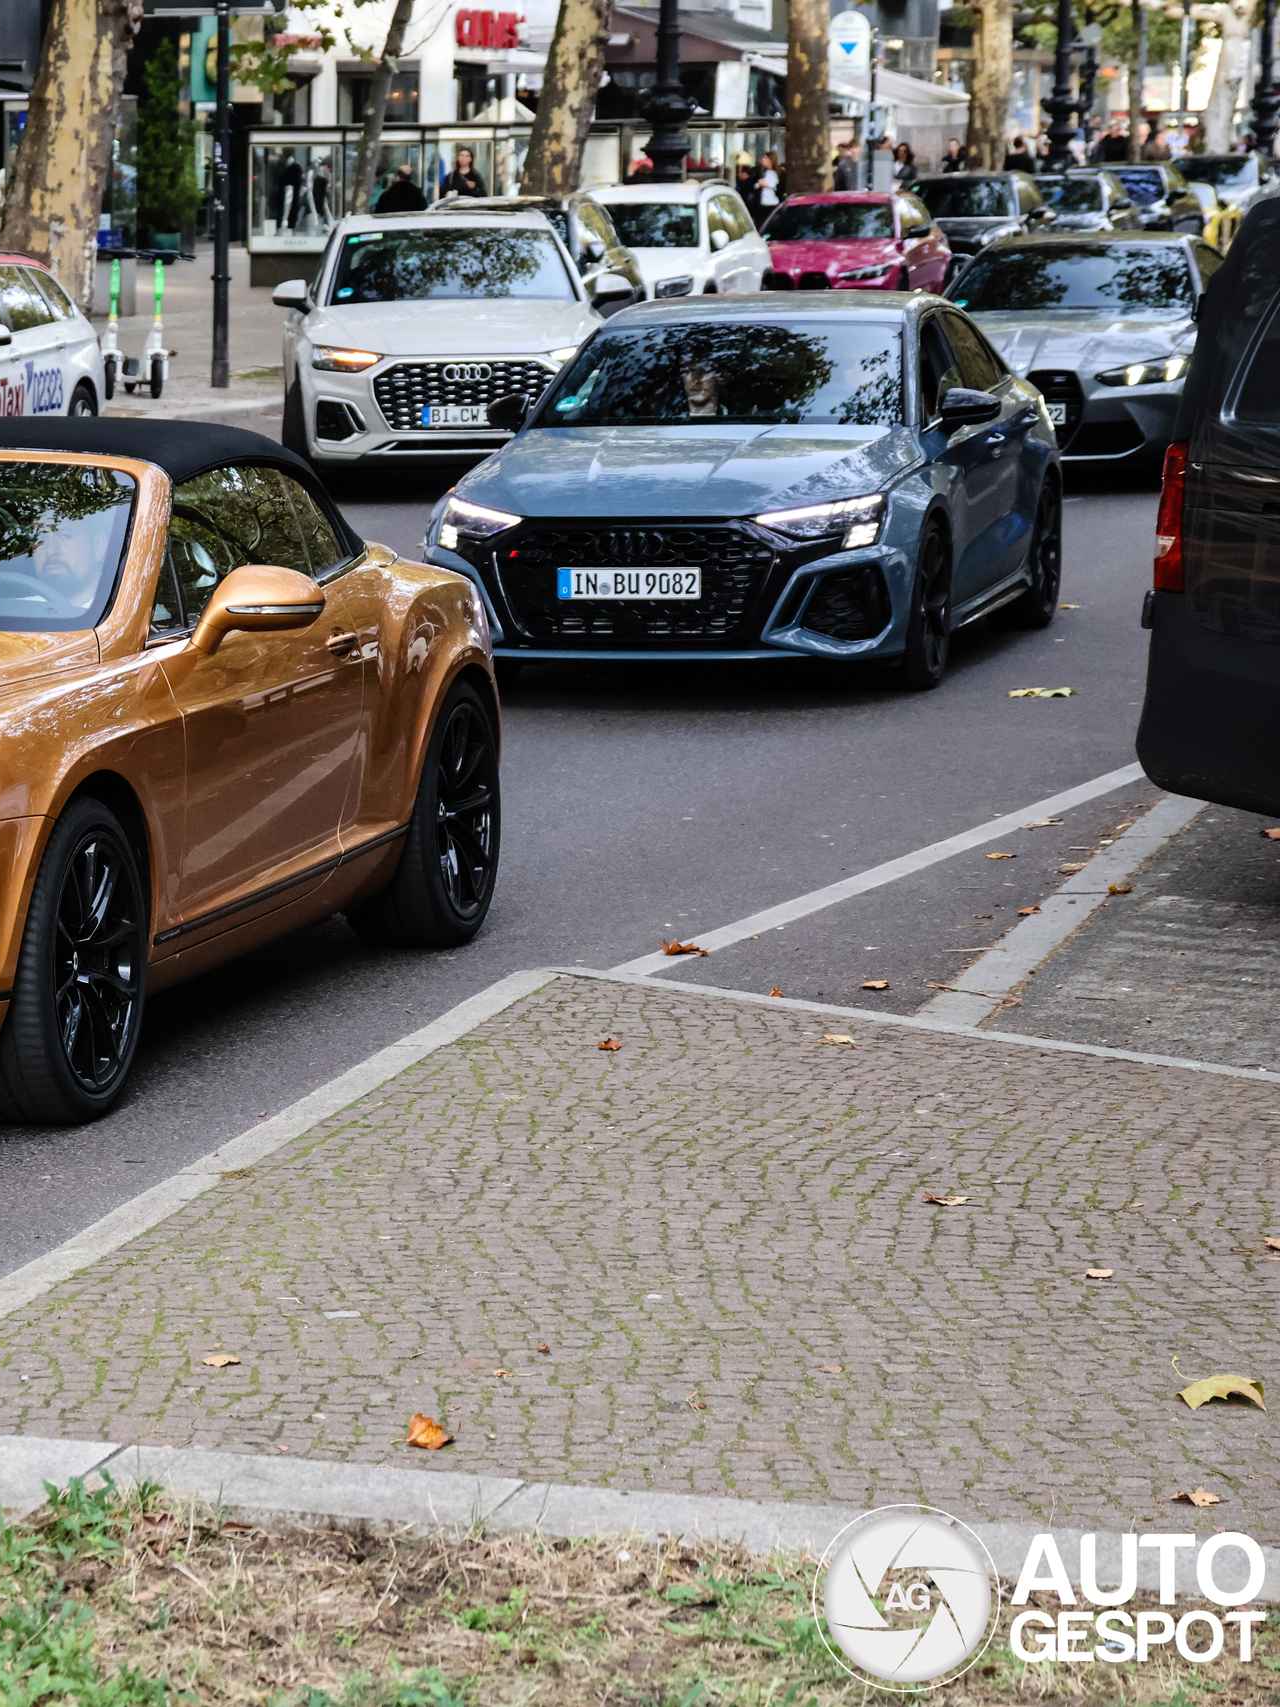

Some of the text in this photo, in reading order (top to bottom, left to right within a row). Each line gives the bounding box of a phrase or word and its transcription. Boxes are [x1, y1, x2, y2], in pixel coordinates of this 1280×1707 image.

[431, 408, 451, 423] BI
[460, 408, 480, 422] CW
[574, 572, 598, 595] IN
[613, 572, 640, 595] BU
[645, 572, 697, 595] 9082
